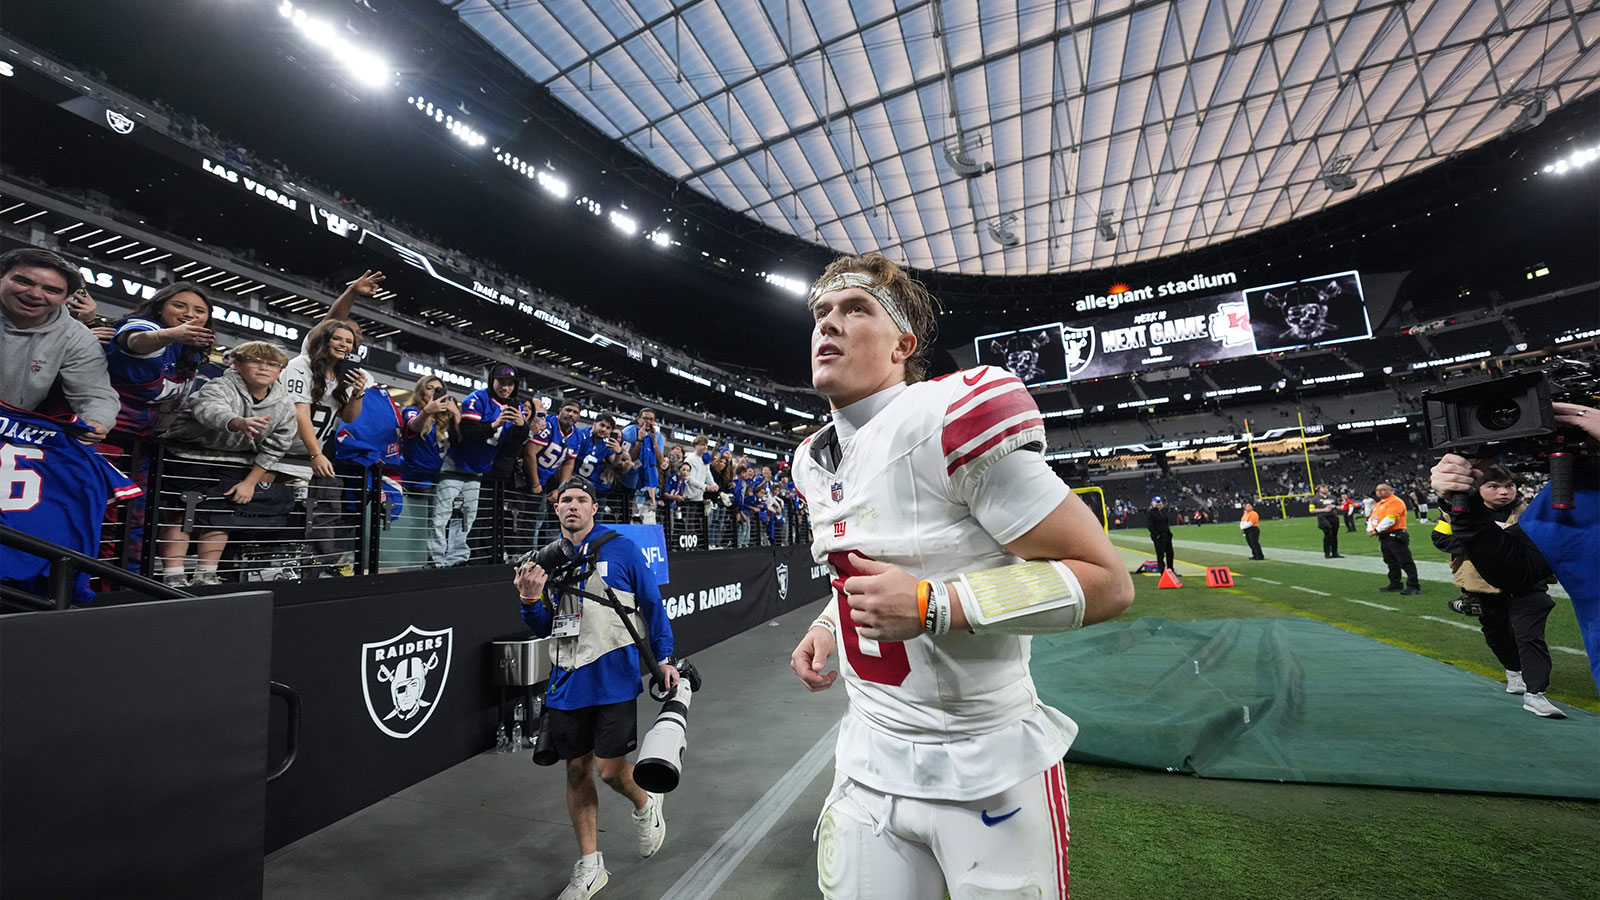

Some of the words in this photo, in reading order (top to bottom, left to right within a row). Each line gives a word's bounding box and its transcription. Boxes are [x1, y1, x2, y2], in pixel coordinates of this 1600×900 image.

[202, 158, 238, 184] LAS
[242, 176, 297, 211] VEGAS
[79, 266, 113, 288] AS
[212, 305, 299, 341] RAIDERS
[1076, 285, 1154, 312] allegiant
[1158, 271, 1237, 297] stadium
[473, 281, 499, 300] THANK
[518, 301, 534, 315] FOR
[534, 309, 571, 331] ATTENDING
[1134, 312, 1158, 325] WEEK
[1101, 325, 1147, 353] NEXT
[1149, 314, 1209, 346] GAME
[1554, 335, 1574, 344] LAS
[1574, 329, 1600, 339] VEGA
[287, 379, 304, 394] 98
[409, 361, 432, 377] LAS
[433, 368, 473, 388] VEGAS
[0, 442, 45, 513] 6
[578, 454, 598, 478] 6
[679, 534, 698, 548] C109
[1210, 569, 1230, 585] 10
[699, 582, 742, 611] RAIDERS
[375, 636, 443, 662] RAIDERS
